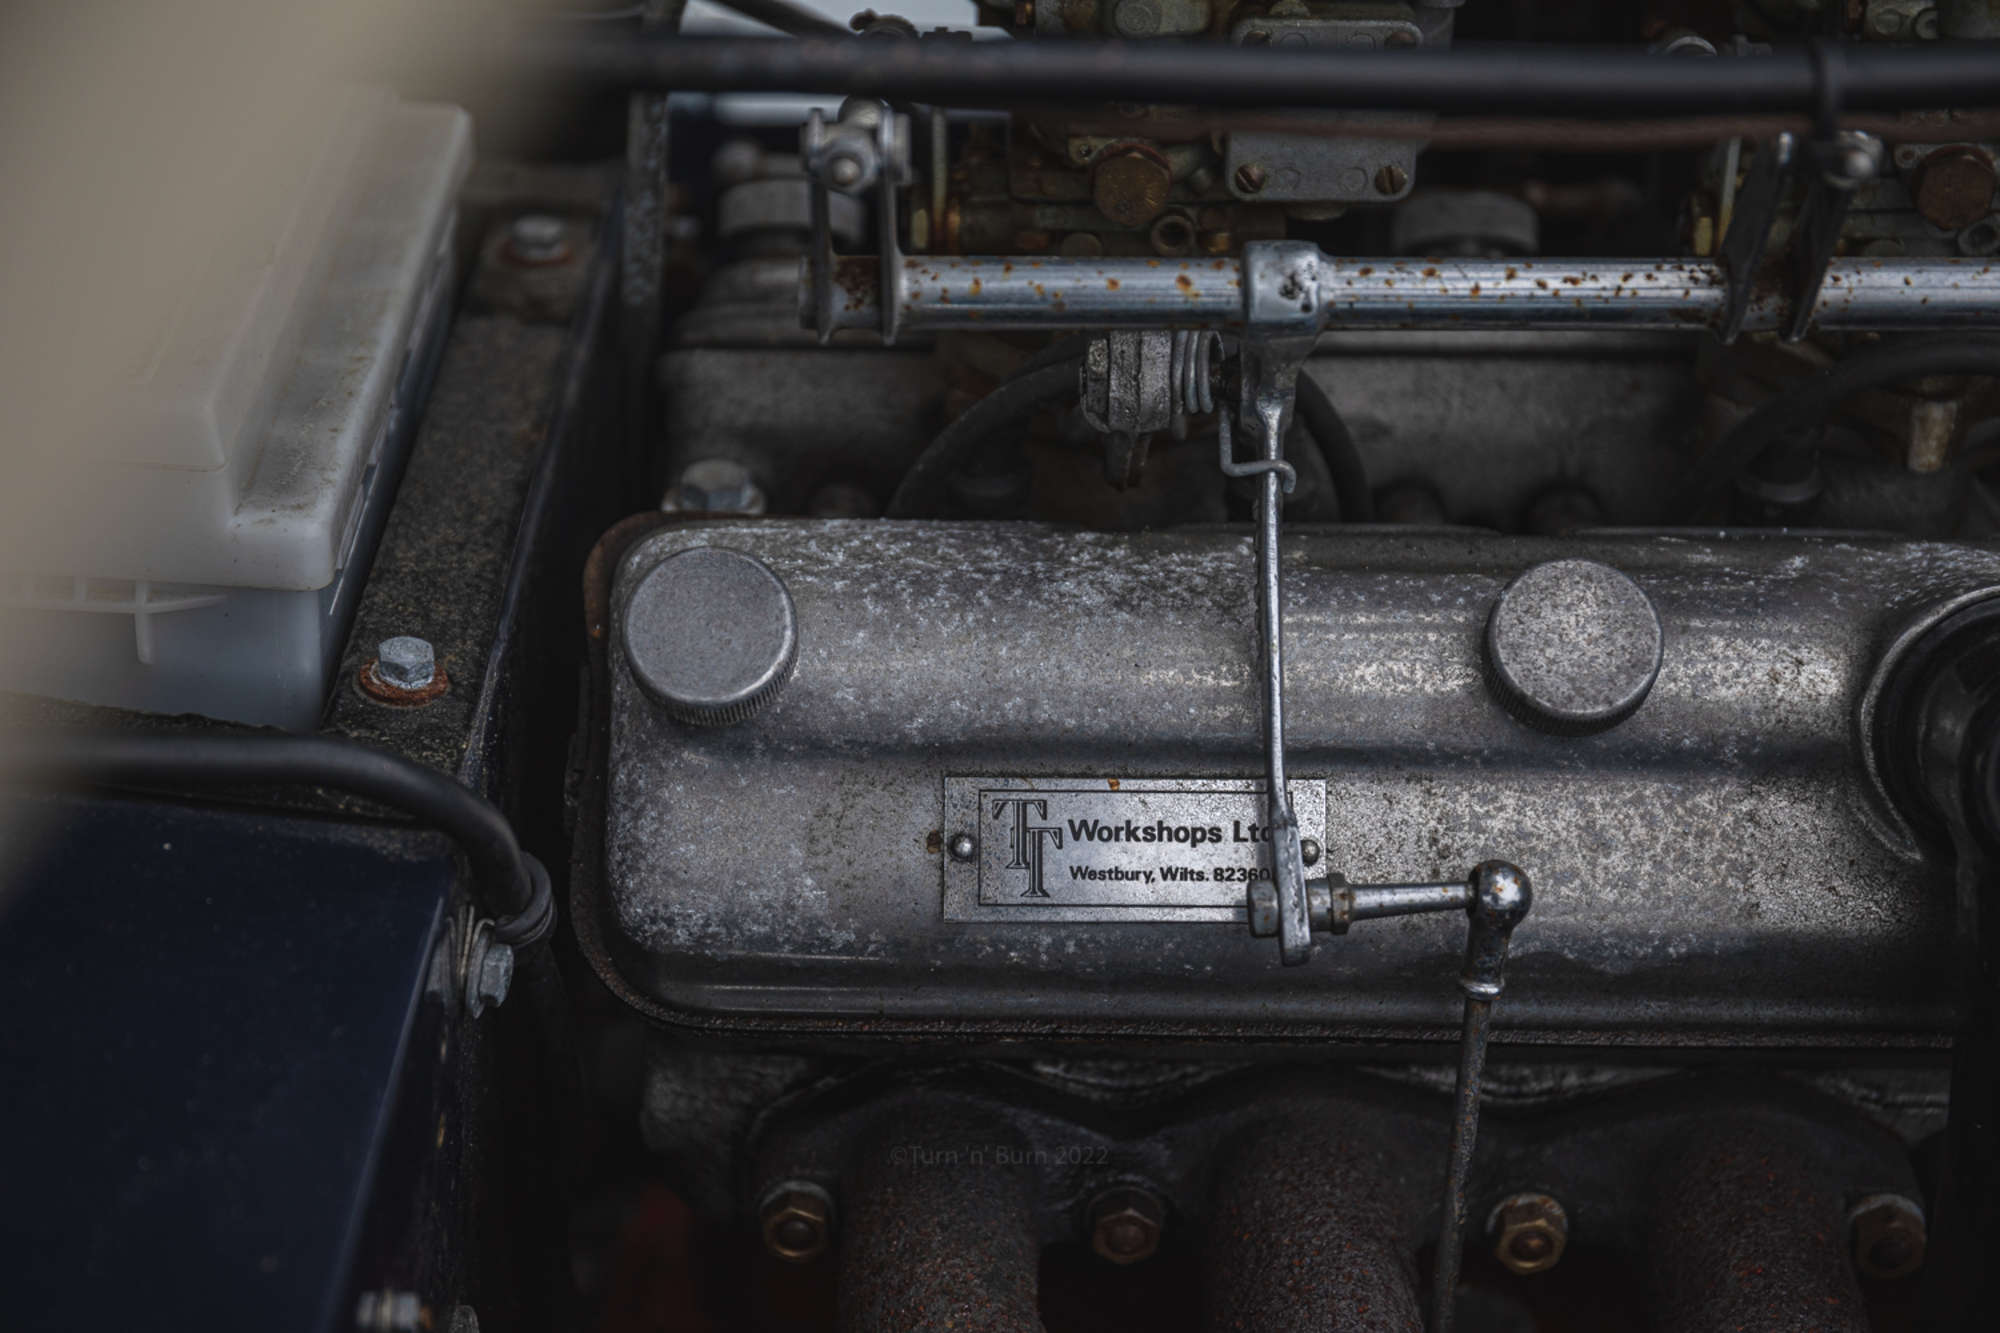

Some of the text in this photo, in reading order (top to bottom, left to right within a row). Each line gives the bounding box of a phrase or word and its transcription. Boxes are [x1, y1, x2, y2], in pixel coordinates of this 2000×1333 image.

[1068, 819, 1223, 848] Workshops
[1070, 865, 1156, 883] Westbury,
[1159, 866, 1209, 882] Wilts.
